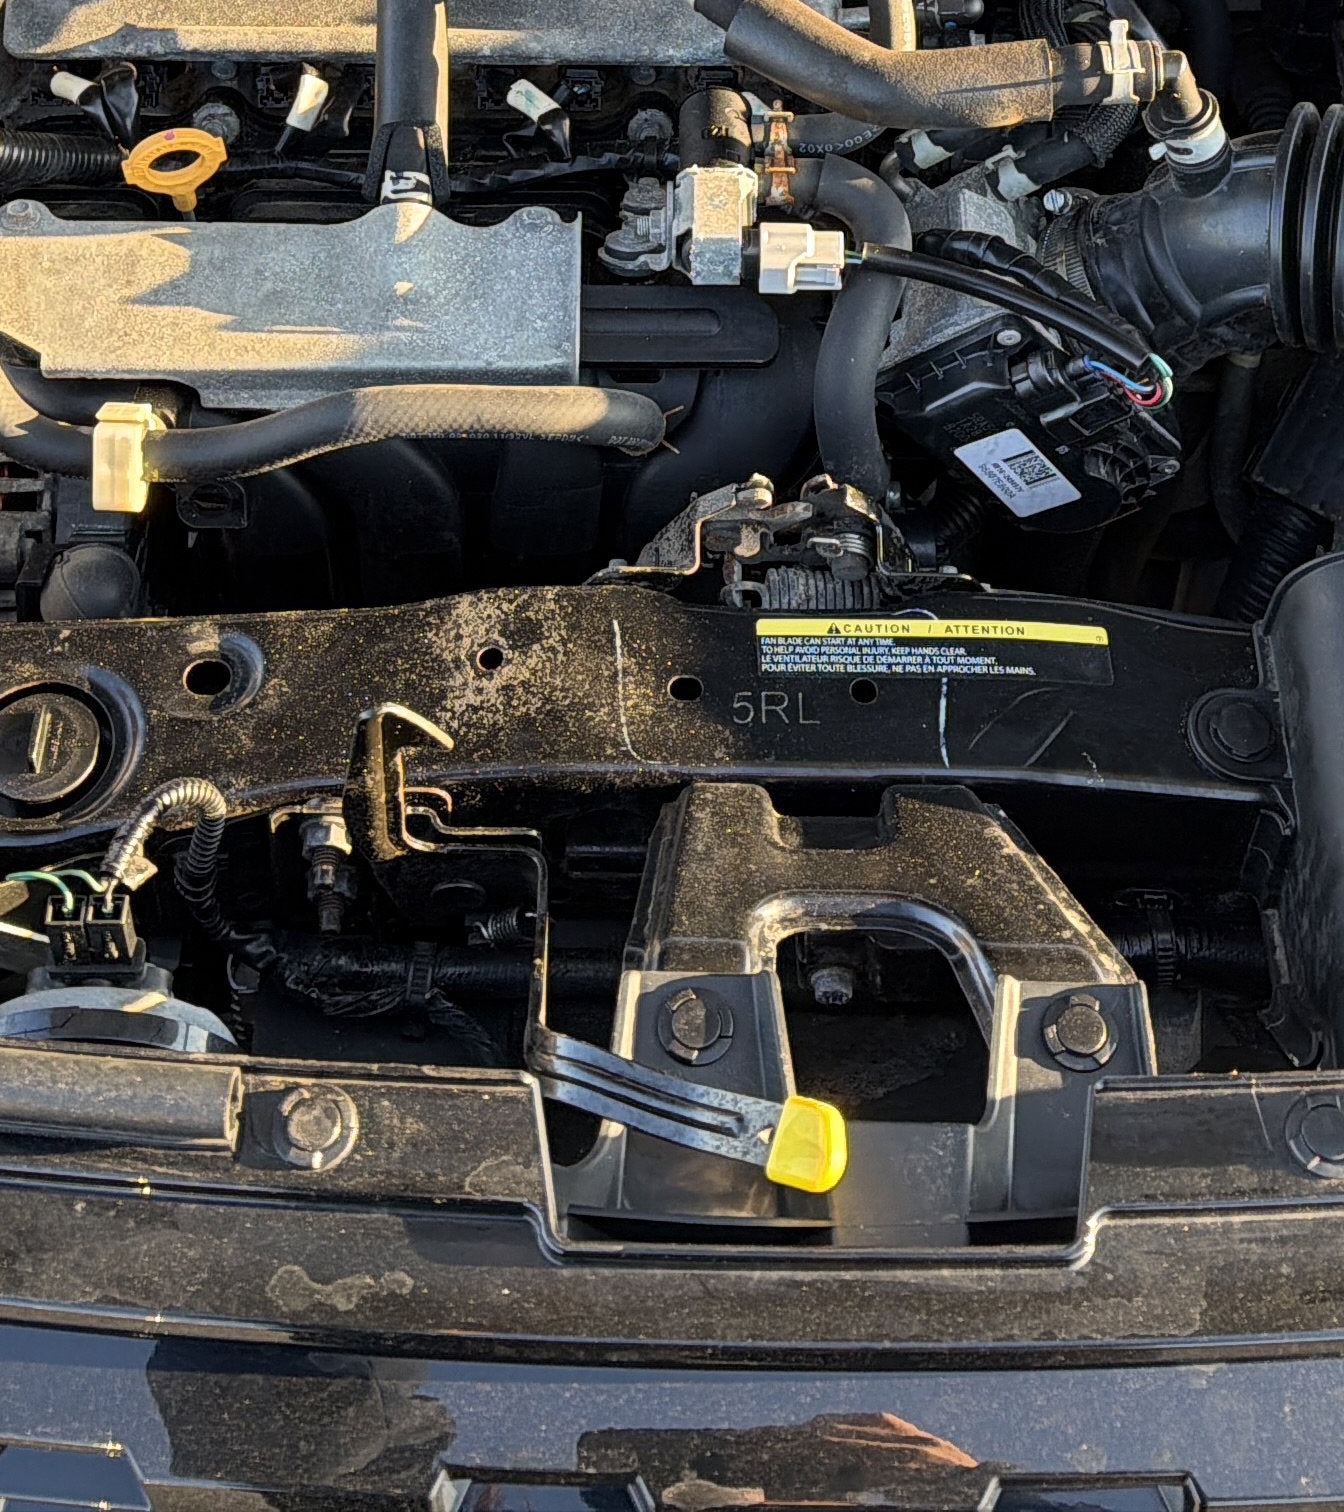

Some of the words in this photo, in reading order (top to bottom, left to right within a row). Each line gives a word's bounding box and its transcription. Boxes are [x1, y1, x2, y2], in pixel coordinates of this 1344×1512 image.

[843, 624, 911, 634] CAUTION
[944, 624, 1026, 636] ATTENTION
[761, 637, 777, 645] FAN
[777, 637, 803, 645] BLADE
[803, 637, 821, 645] CAN
[822, 637, 845, 645] START
[846, 637, 856, 645] AT
[857, 637, 876, 645] ANY
[876, 637, 896, 645] TIME.
[762, 646, 774, 654] TO
[774, 646, 794, 654] HELP
[795, 646, 820, 654] AVOID
[820, 646, 861, 655] PERSONAL
[891, 646, 910, 655] KEEP
[911, 646, 940, 656] HANDS
[761, 654, 773, 663] LE
[773, 654, 829, 663] VENTILATEUR
[830, 655, 862, 664] RISQUE
[862, 655, 875, 664] DE
[932, 656, 955, 665] TOUT
[956, 656, 999, 666] MOMENT.
[761, 663, 787, 673] POUR
[817, 664, 846, 673] TOUTE
[892, 665, 905, 674] NE
[905, 665, 923, 674] PAS
[922, 665, 935, 674] EN
[935, 665, 989, 675] APPROCHER
[989, 666, 1005, 675] LES
[733, 691, 821, 724] 5RL
